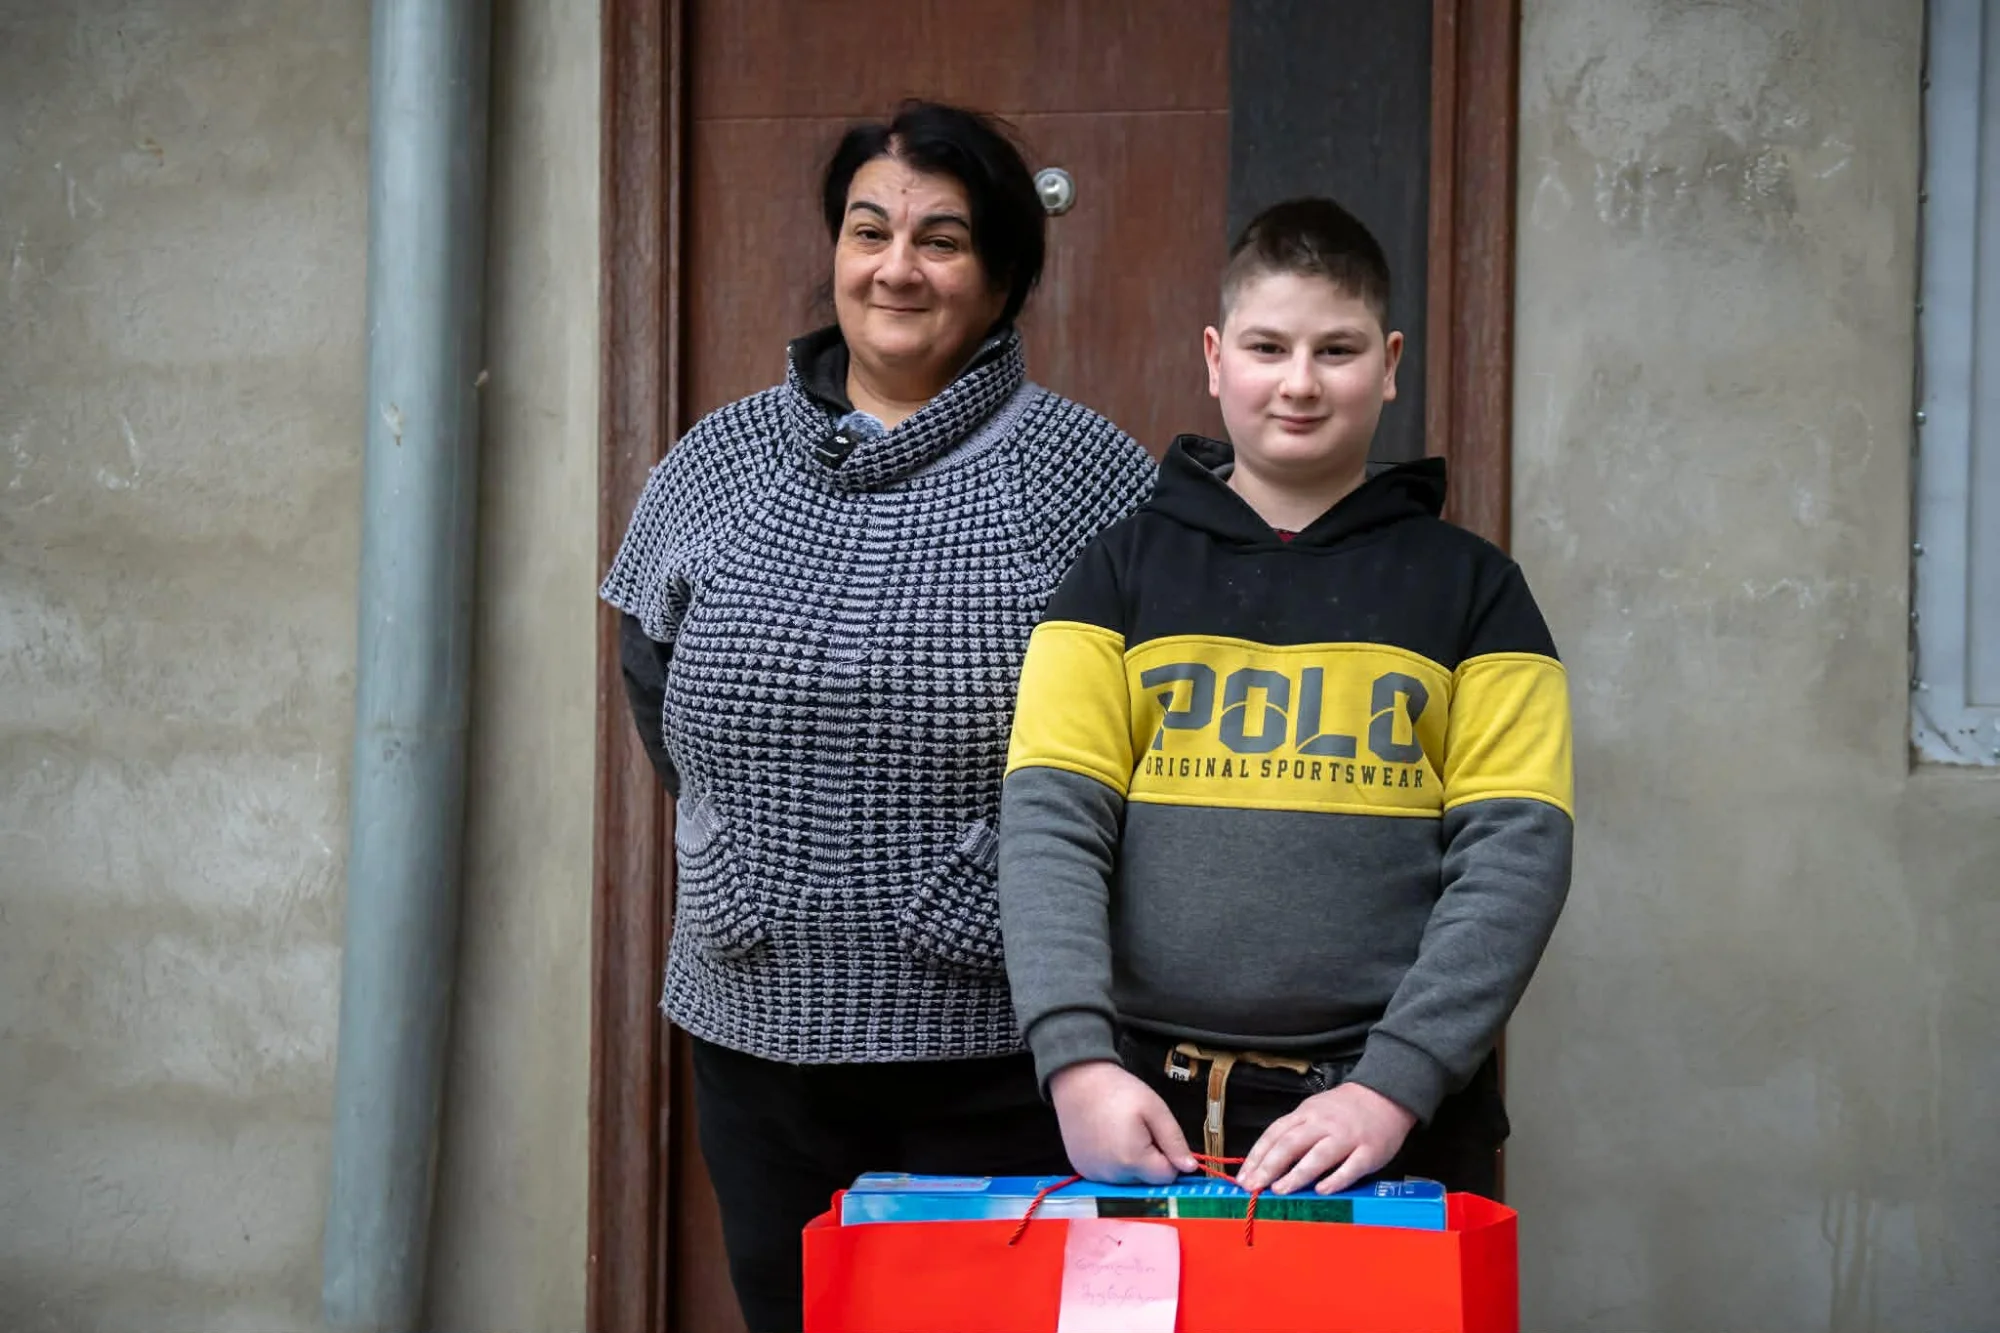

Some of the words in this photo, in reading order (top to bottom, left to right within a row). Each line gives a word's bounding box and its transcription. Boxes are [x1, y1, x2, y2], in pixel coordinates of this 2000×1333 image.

[1140, 662, 1429, 763] POLO
[1145, 756, 1249, 778] ORIGINAL
[1260, 758, 1423, 788] SPORTSWEAR
